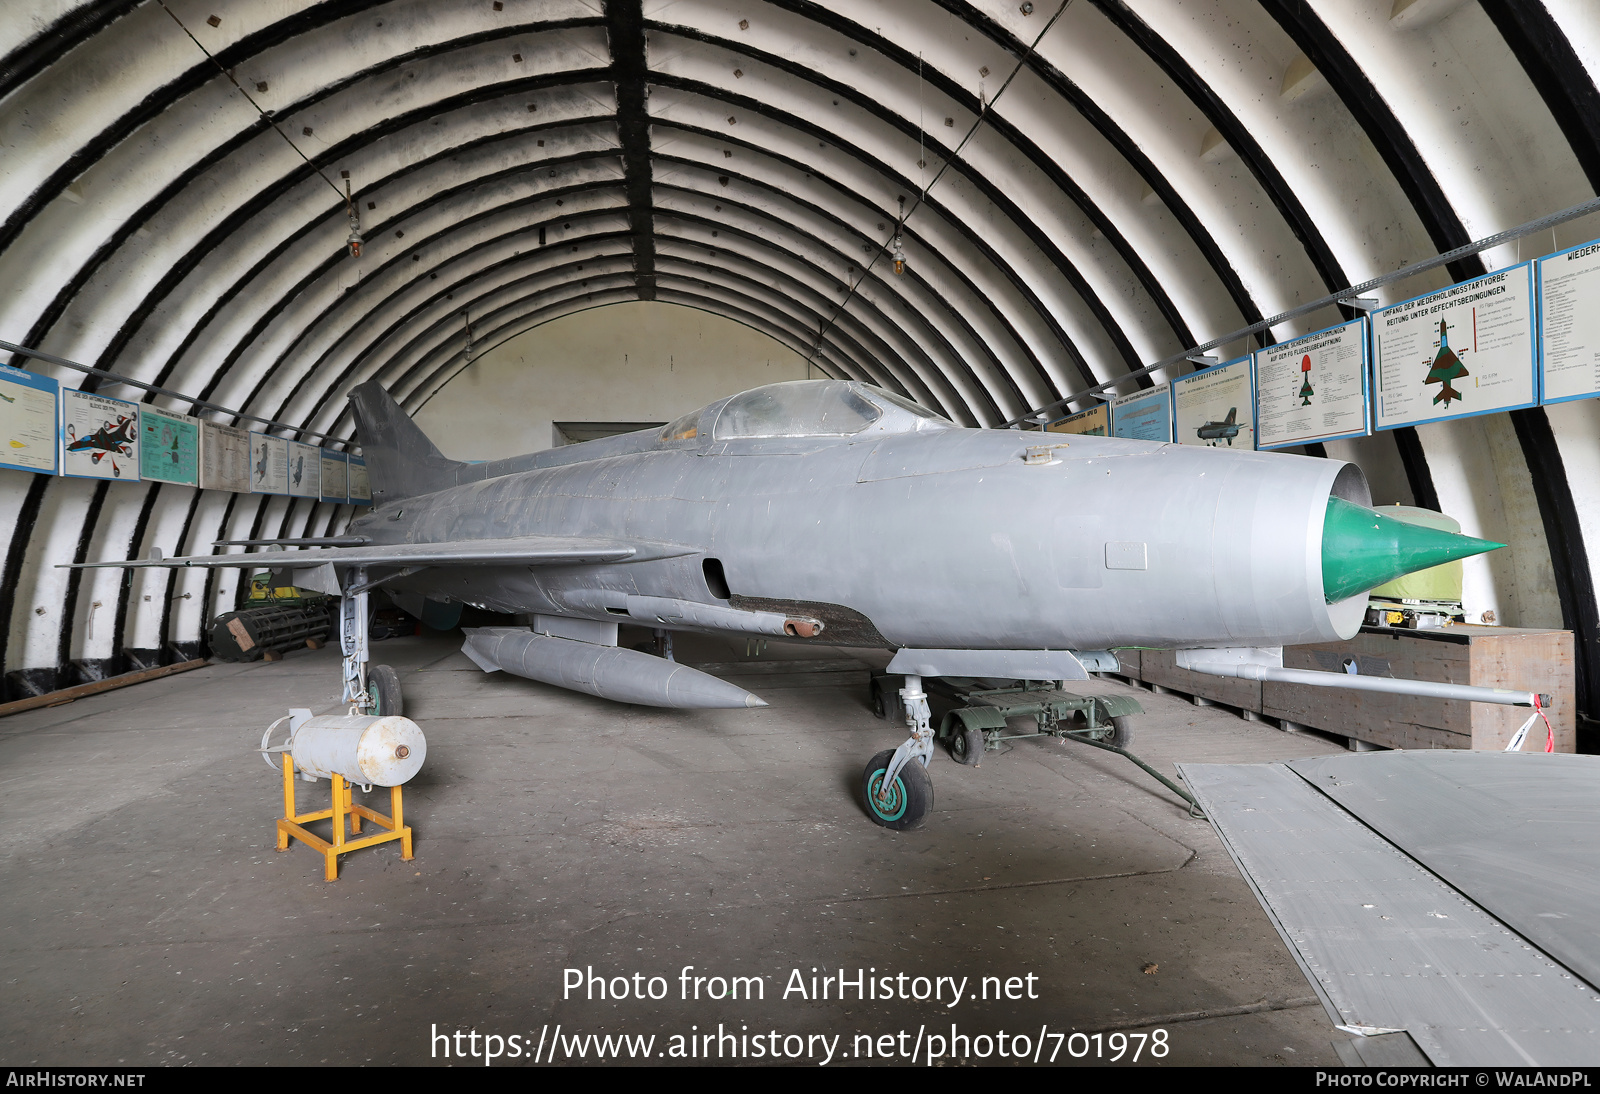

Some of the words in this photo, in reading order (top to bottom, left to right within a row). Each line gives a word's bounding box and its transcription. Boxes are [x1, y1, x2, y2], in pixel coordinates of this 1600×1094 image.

[1383, 306, 1402, 317] UMFANG
[1404, 302, 1414, 311] DER
[1416, 273, 1508, 307] WIEDERHOLUNGSSTARTVORBE-
[1386, 314, 1409, 326] REITUNG
[1411, 309, 1429, 320] UNTER
[1430, 285, 1506, 314] GEFECHTSBEDINGUNGEN
[1267, 344, 1290, 355] ALLGEMEINE
[1290, 326, 1346, 349] SICHERHEITSBESTIMMUNGEN
[1293, 336, 1342, 356] FLUGZEUGBEWAFFNUNG
